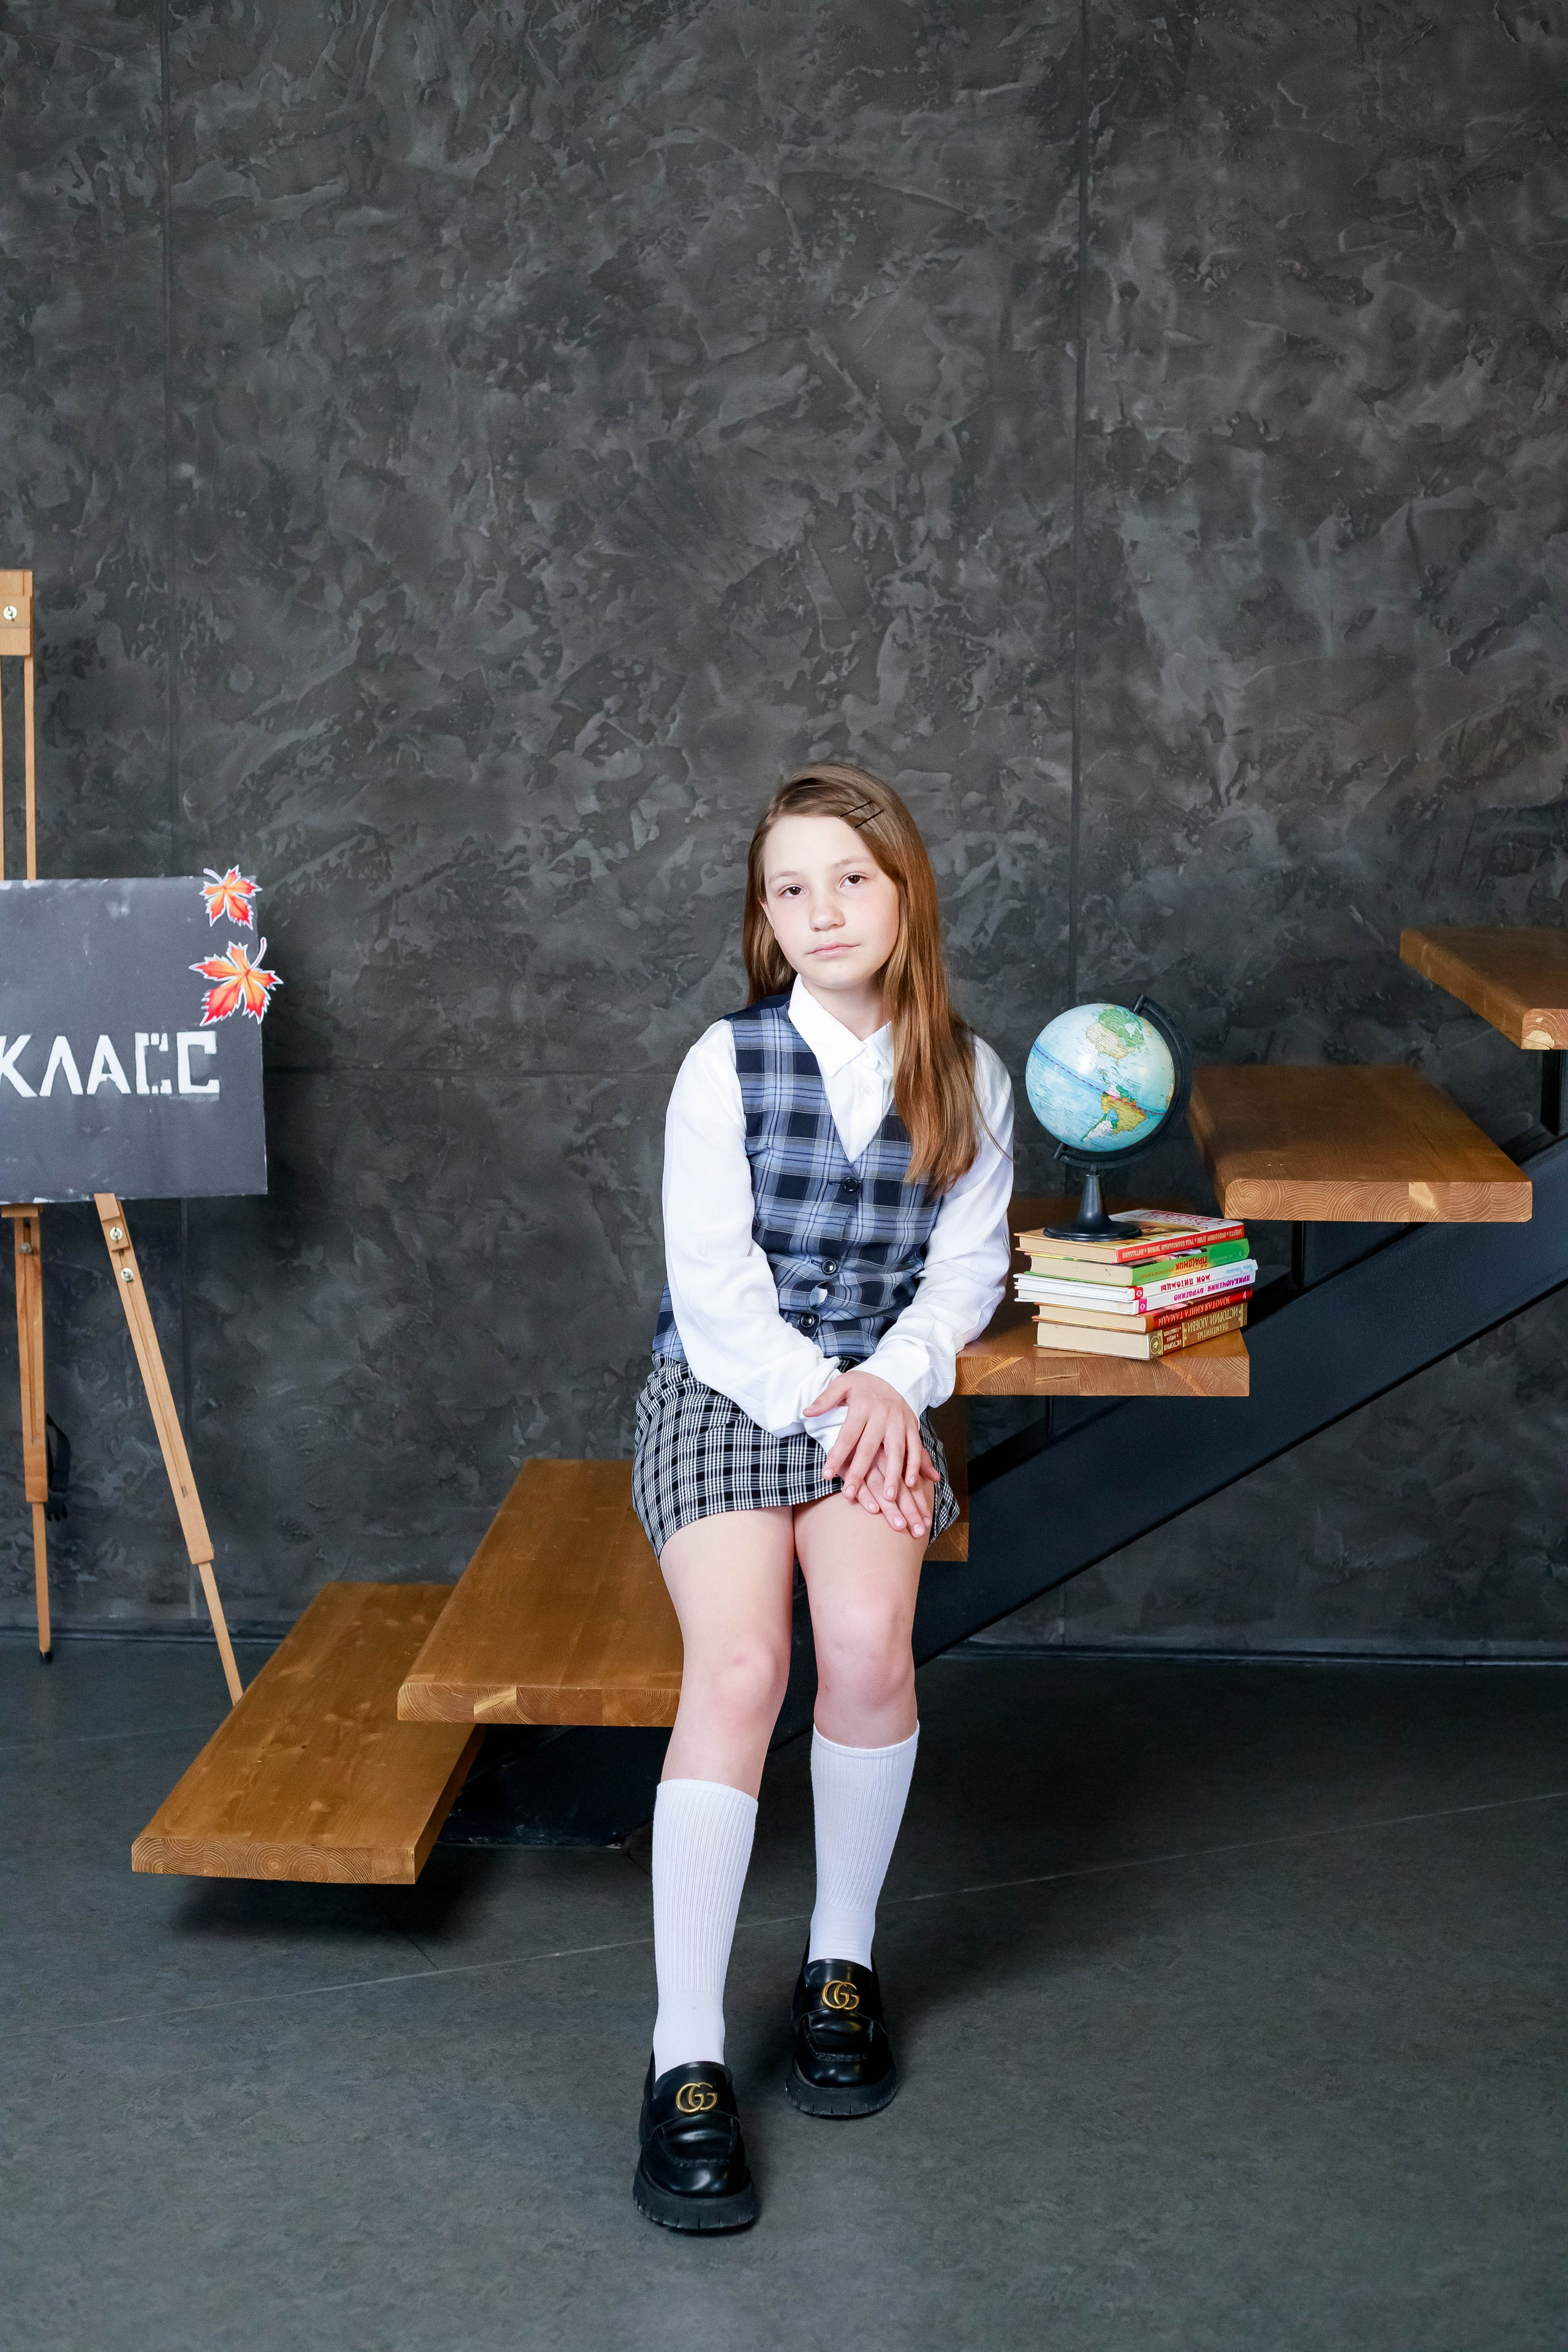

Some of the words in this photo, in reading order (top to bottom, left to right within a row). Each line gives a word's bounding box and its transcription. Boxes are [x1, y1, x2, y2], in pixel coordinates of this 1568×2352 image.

[0, 1031, 220, 1098] КЛАСС
[1161, 1278, 1194, 1292] ПИТОМЦЫ
[1196, 1273, 1211, 1284] МОИ
[1207, 1275, 1251, 1292] ПРИКЛЮЧЕНИЯ
[1185, 1305, 1205, 1318] КНИГА
[1204, 1295, 1231, 1312] ЗОЛОТАЯ
[1158, 1314, 1186, 1327] ТАМАДЫ
[1210, 1306, 1239, 1325] ИСТОРИИ
[1187, 1316, 1209, 1334] ЛЮБВИ
[1197, 1322, 1229, 1340] ЗНАМЕНИТЫЕ
